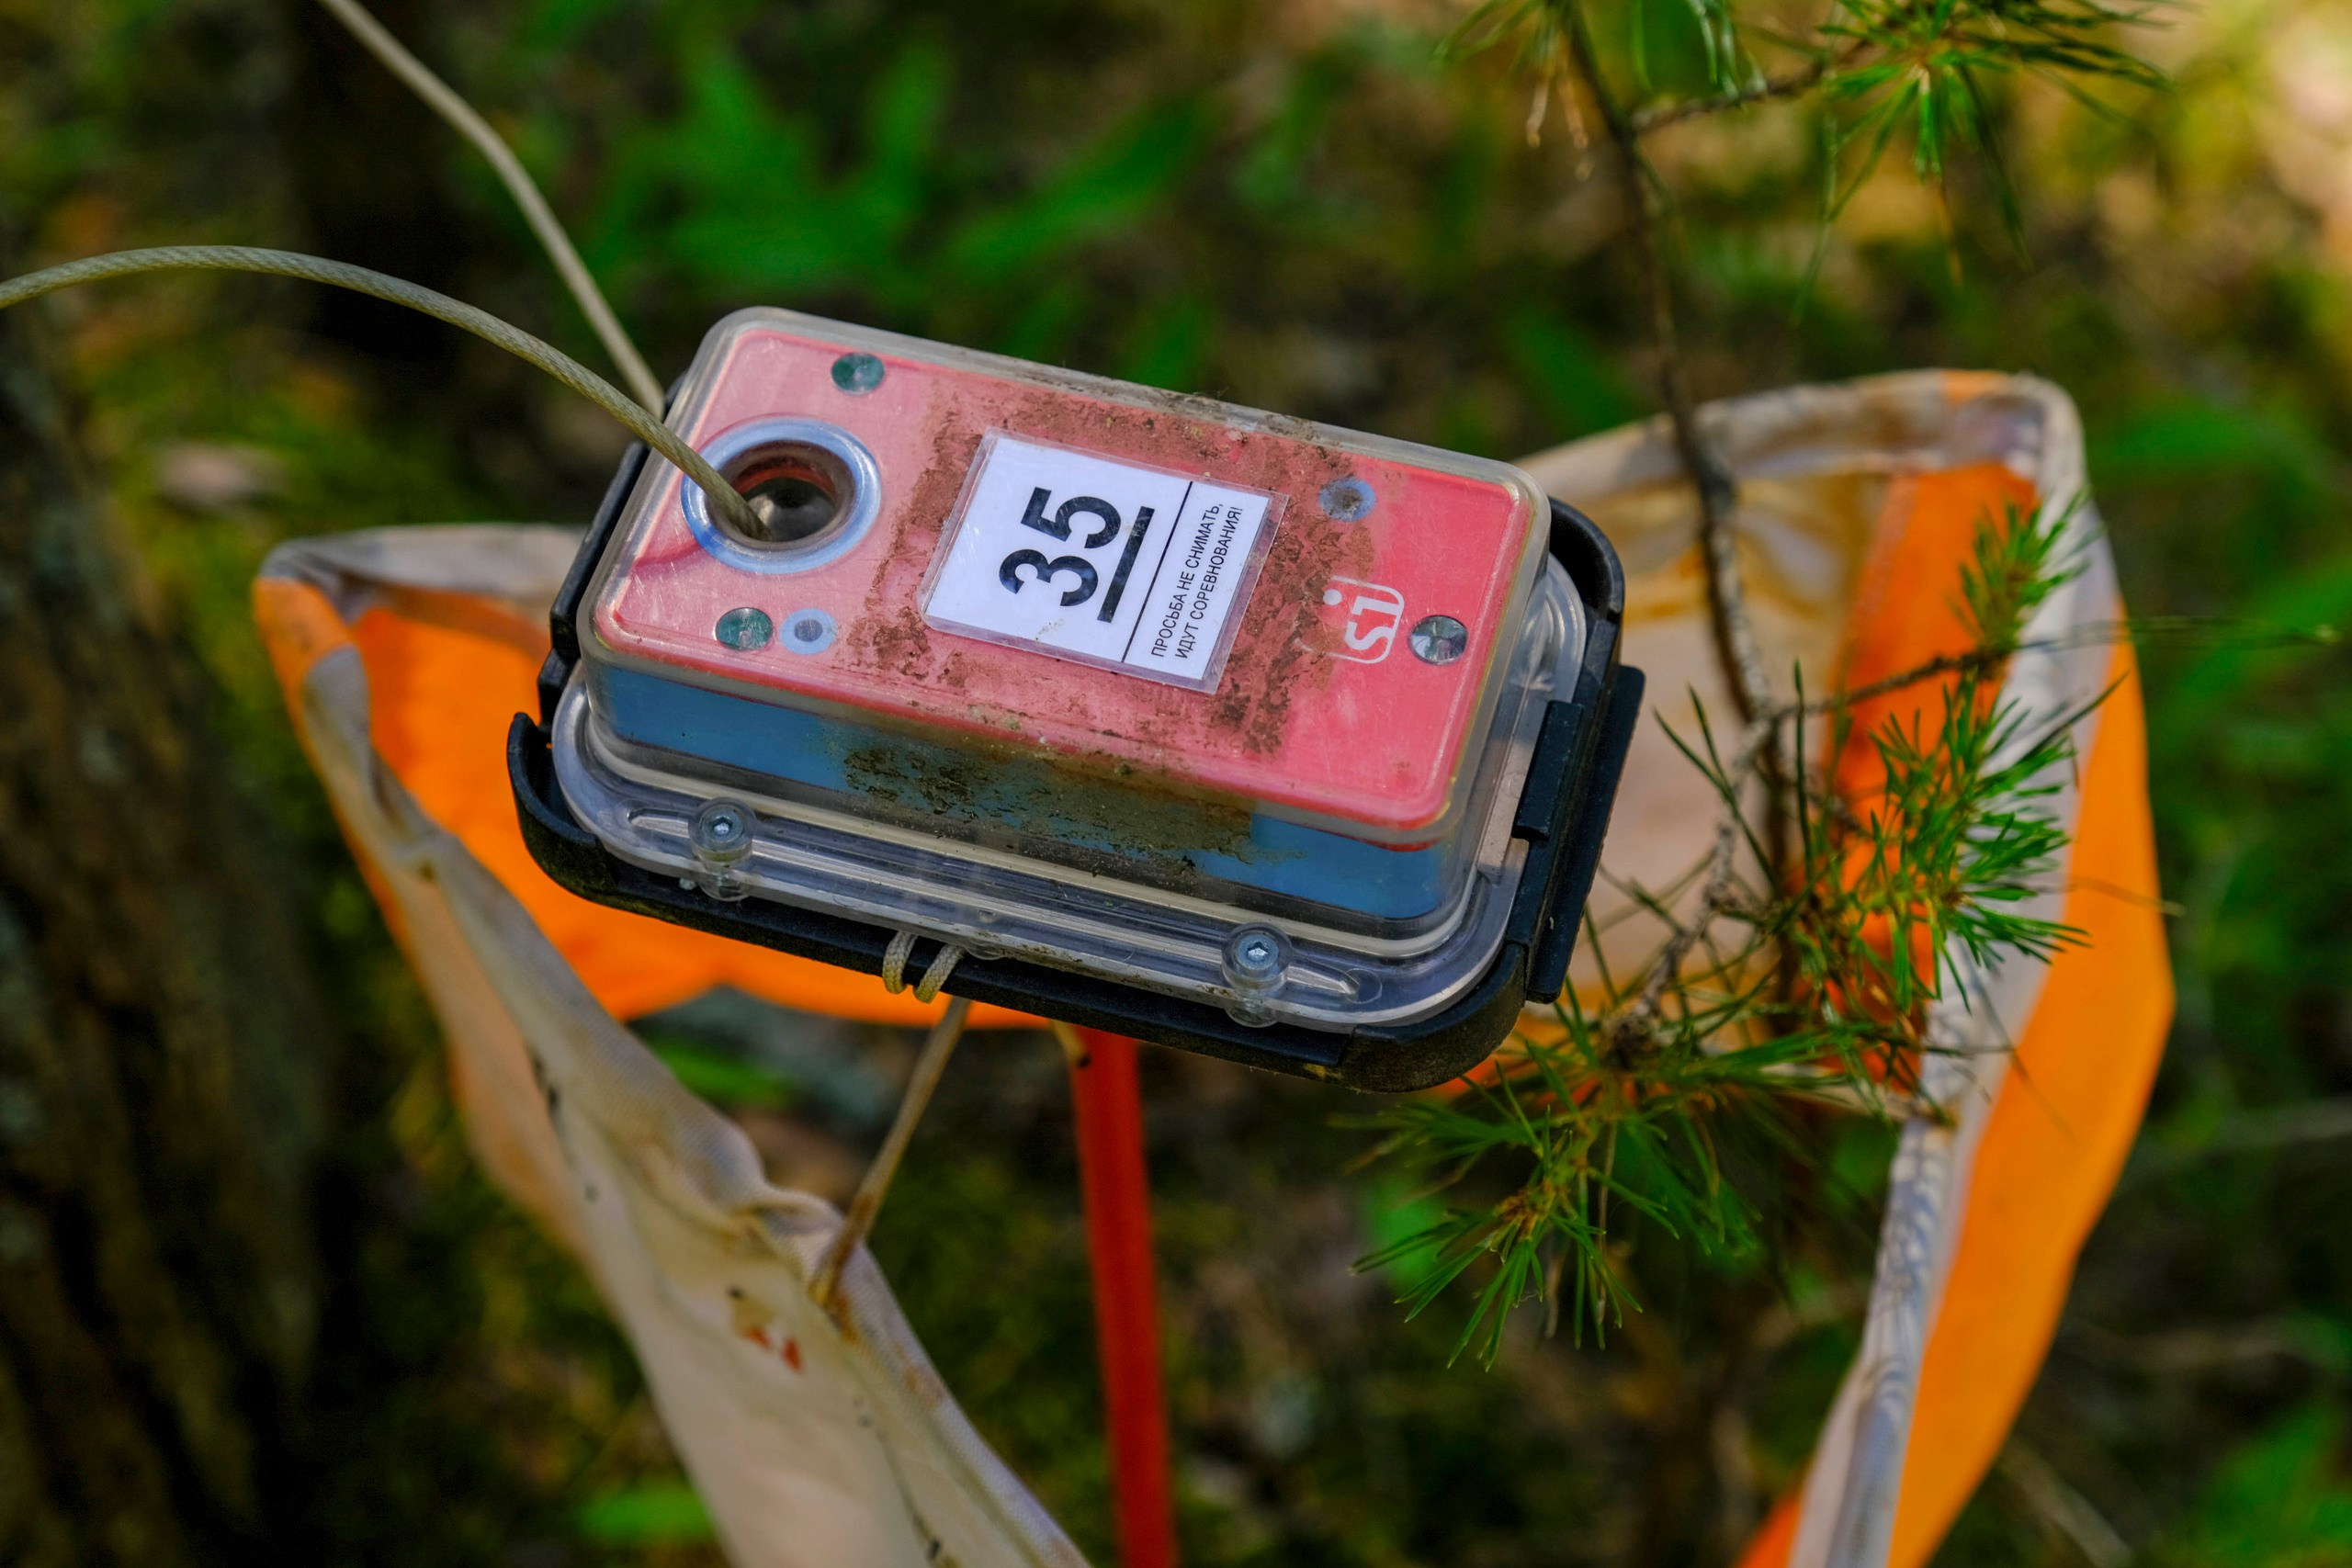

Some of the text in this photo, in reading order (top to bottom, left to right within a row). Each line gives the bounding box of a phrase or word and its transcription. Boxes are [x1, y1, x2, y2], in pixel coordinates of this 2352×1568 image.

[999, 487, 1122, 607] 35
[1150, 503, 1225, 658] ПРОСЬБА НЕ СНИМАТЬ,
[1175, 506, 1243, 659] ИДУТ СОРЕВНОВАНИЯ!
